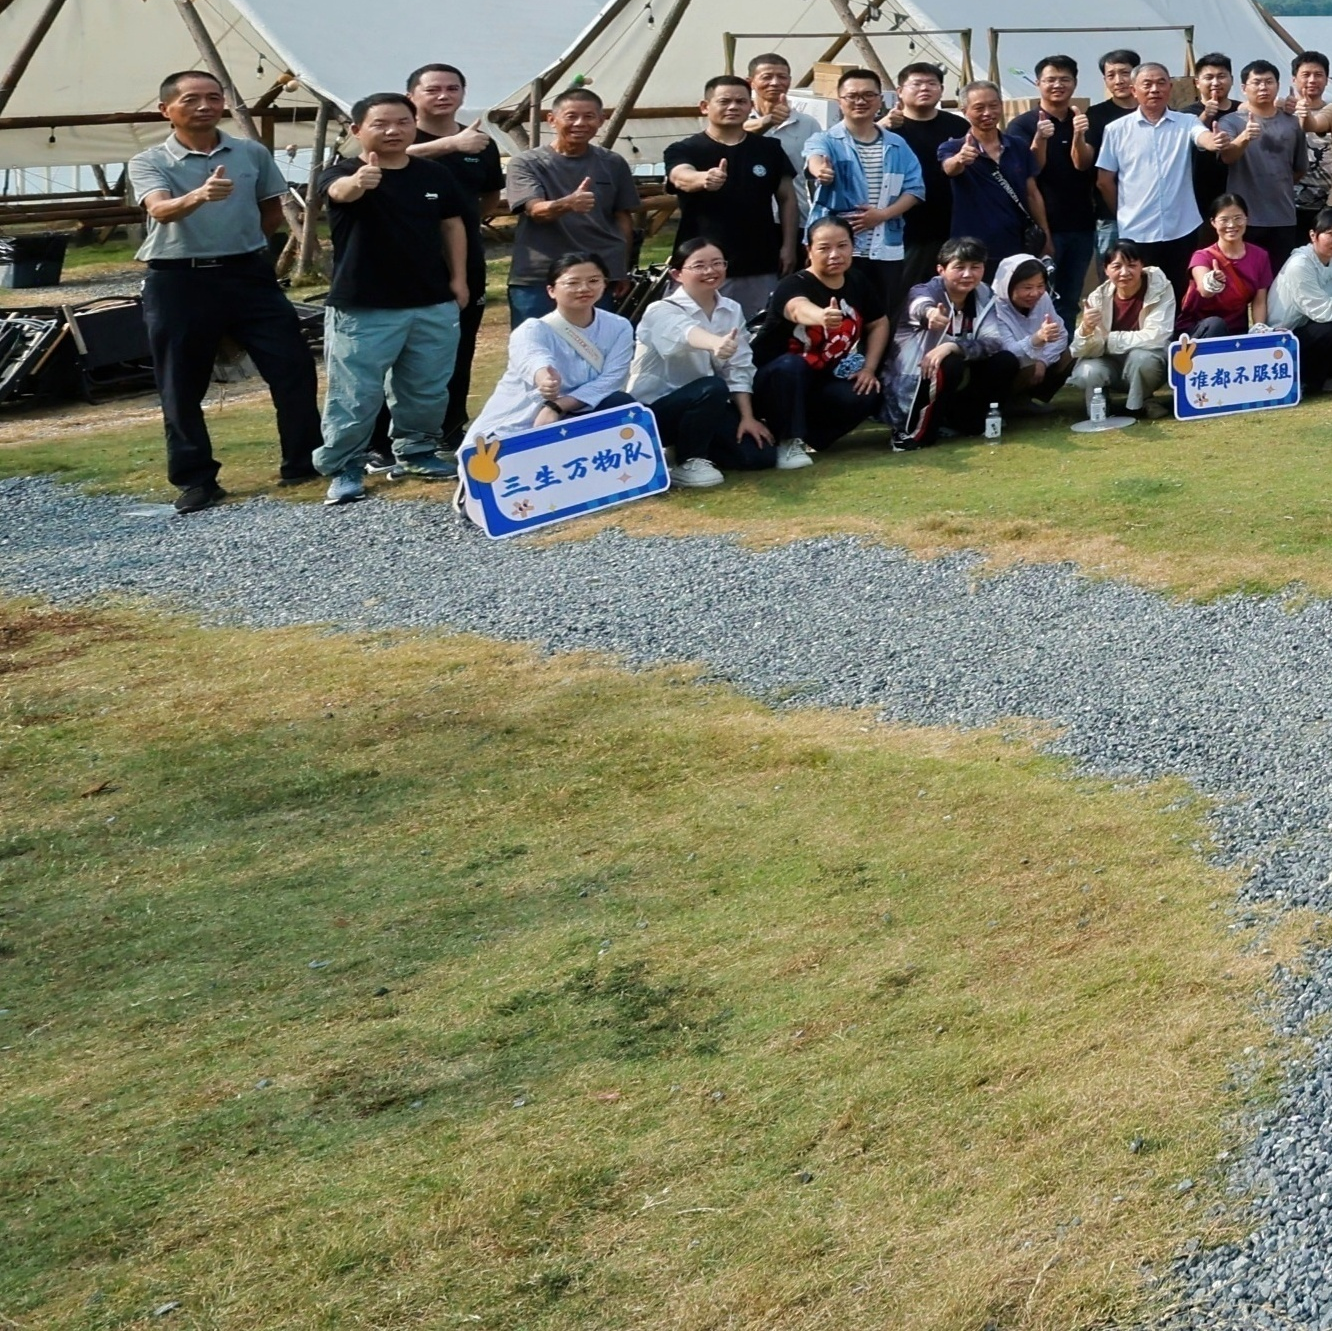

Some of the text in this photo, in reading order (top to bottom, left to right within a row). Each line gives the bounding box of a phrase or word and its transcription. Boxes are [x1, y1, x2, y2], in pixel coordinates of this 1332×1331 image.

[1189, 362, 1292, 390] 谁都不服组
[500, 441, 653, 498] 三生万物队
